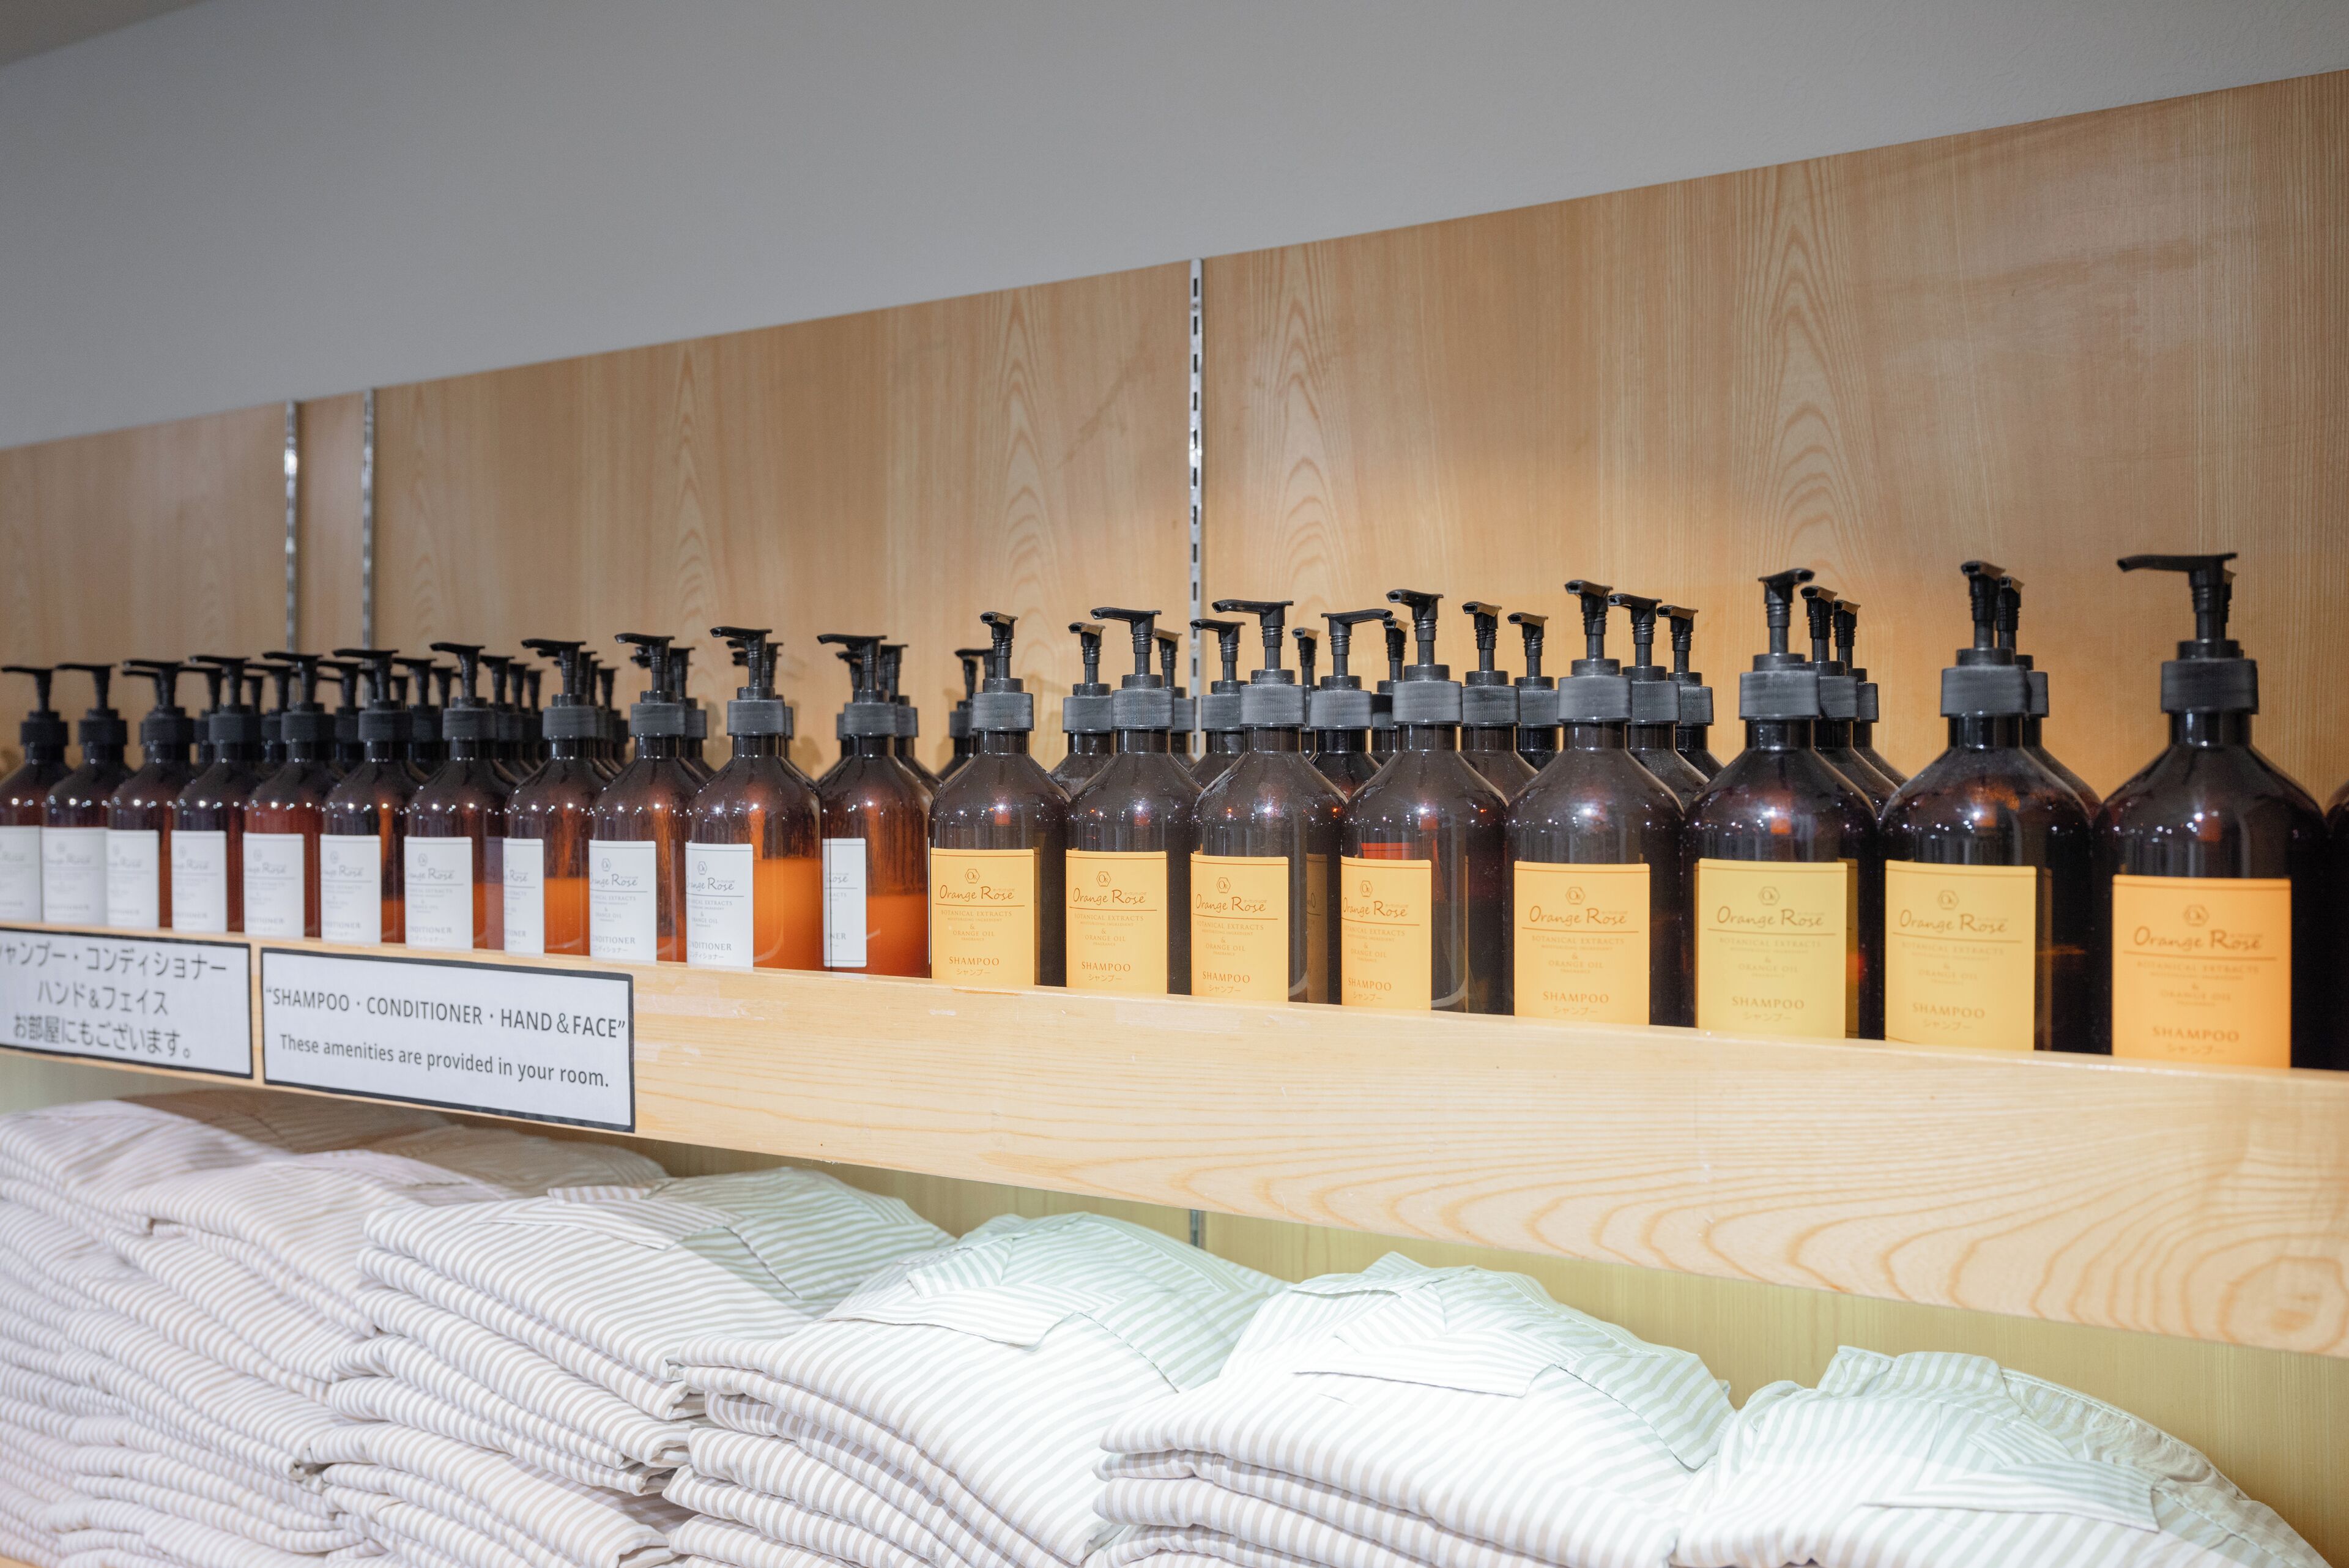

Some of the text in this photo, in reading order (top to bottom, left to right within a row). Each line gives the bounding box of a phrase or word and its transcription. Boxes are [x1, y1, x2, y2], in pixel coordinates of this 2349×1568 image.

[940, 885, 1014, 902] Orange Rose
[1073, 887, 1146, 905] Orange Rose
[1196, 893, 1266, 913] Orange Rose
[1343, 897, 1371, 918] Orange
[1529, 905, 1581, 926] Orange
[1716, 905, 1776, 928] Orange
[1900, 909, 1955, 934] Orange
[2134, 926, 2202, 952] Orange
[0, 940, 227, 979] ャンプー・コンディショナー
[949, 956, 1000, 966] SHAMPOO
[1082, 961, 1131, 972] SHAMPOO
[1203, 971, 1250, 983] SHAMPOO
[1348, 977, 1392, 991] SHAMPOO
[37, 980, 169, 1015] ハンド&フェイス
[1209, 984, 1241, 994] シャンプー
[1542, 990, 1609, 1004] SHAMPOO
[367, 997, 483, 1025] CONDITIONER
[1731, 995, 1805, 1009] SHAMPOO
[1912, 1002, 1986, 1019] SHAMPOO
[14, 1013, 191, 1059] お部屋にもございます。
[2151, 1026, 2240, 1042] SHAMPOO
[280, 1034, 609, 1087] These amenities are provided in your room.
